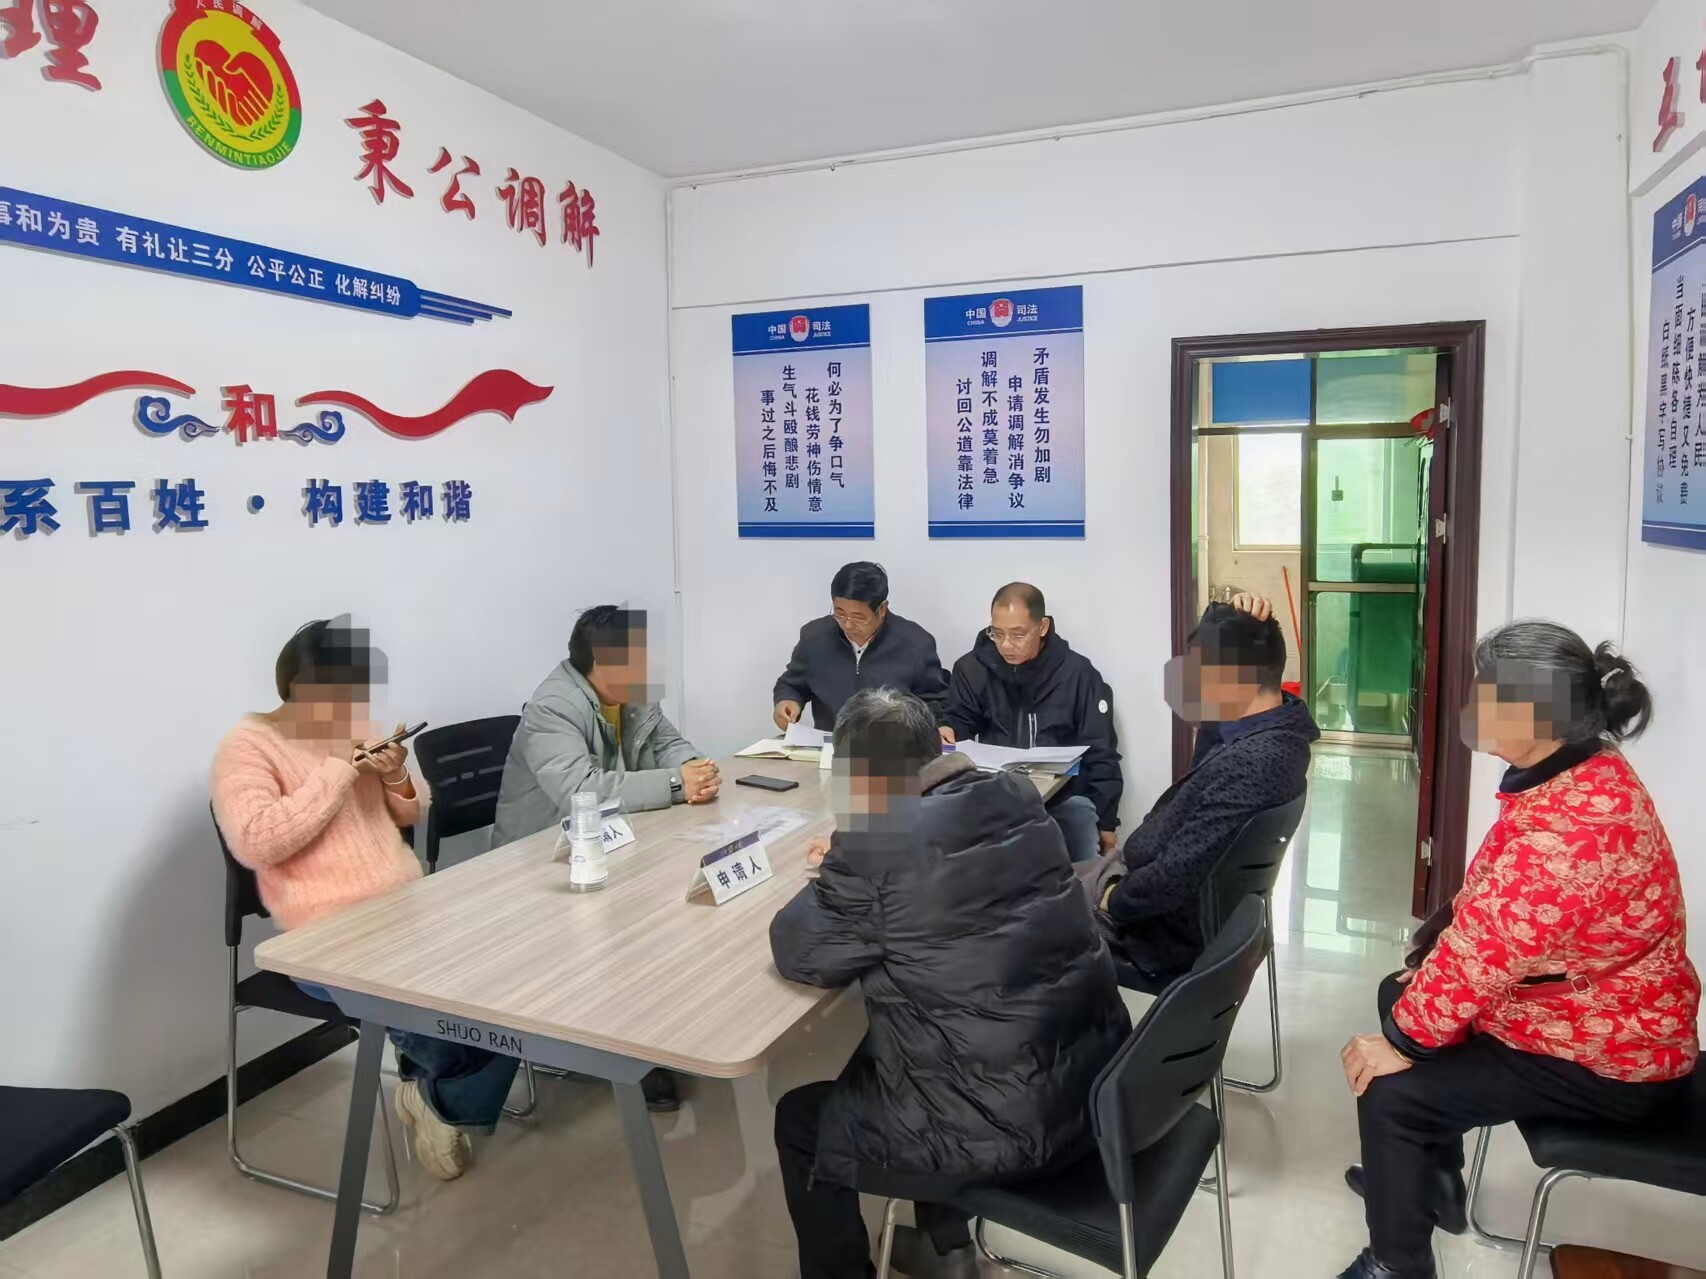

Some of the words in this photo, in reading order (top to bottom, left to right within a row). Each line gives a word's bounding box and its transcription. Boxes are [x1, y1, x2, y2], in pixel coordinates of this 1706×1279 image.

[186, 115, 292, 167] RENMINTIAOJIE
[345, 98, 600, 268] 秉公调解
[116, 226, 234, 272] 有礼让三分
[248, 255, 325, 291] 公平公正
[336, 273, 401, 306] 化解纠纷
[768, 324, 787, 335] 中国
[812, 320, 832, 331] 司法
[965, 307, 987, 320] 中国
[1016, 303, 1038, 315] 司法
[221, 384, 278, 442] 和
[760, 389, 778, 513] 事过之后悔不及
[782, 364, 800, 489] 生气斗殴酿悲剧
[805, 387, 823, 512] 花钱劳神伤情意
[827, 361, 845, 488] 何必为了争口气
[956, 378, 974, 510] 讨回公道靠法律
[981, 351, 999, 484] 调解不成莫着急
[1007, 374, 1025, 509] 申请调解消争议
[1033, 347, 1051, 483] 矛盾发生勿加剧
[716, 855, 763, 889] 申请人
[437, 1019, 481, 1042] SHUO
[489, 1031, 522, 1053] RAN
